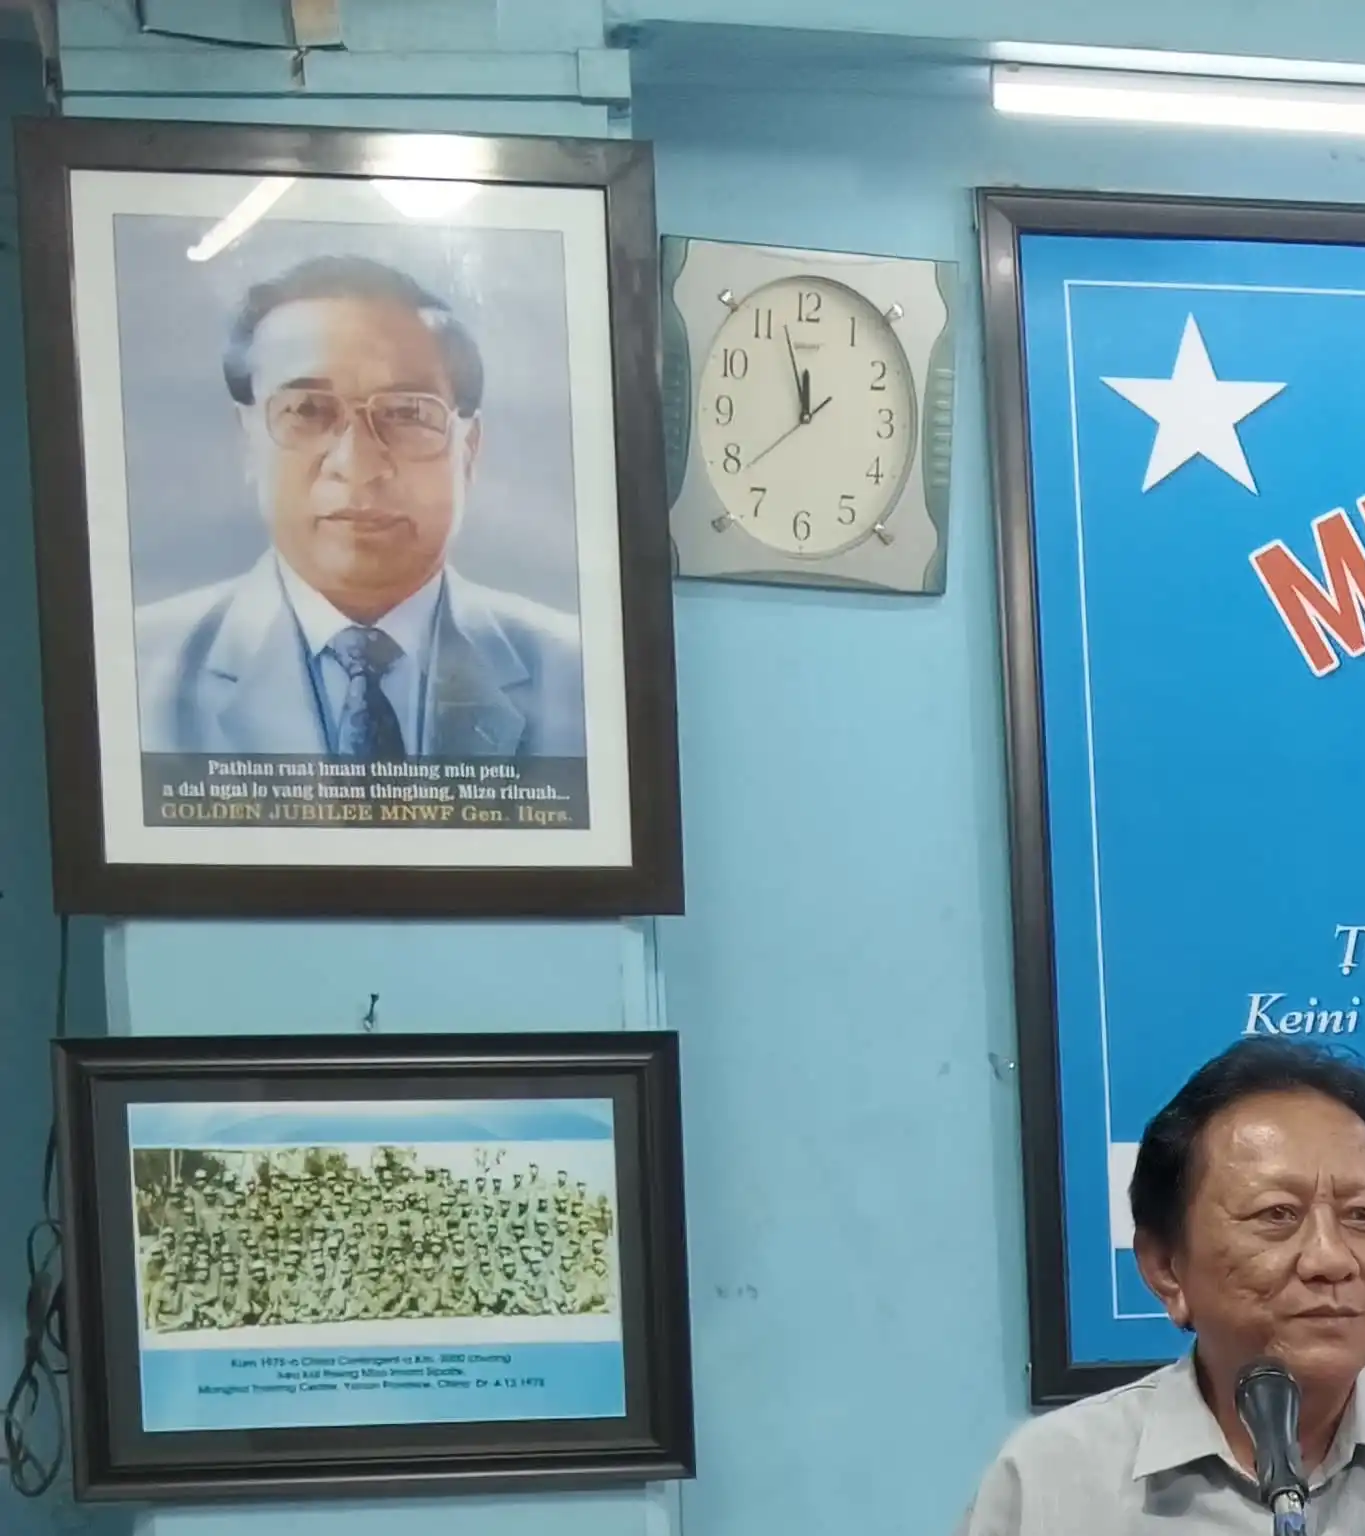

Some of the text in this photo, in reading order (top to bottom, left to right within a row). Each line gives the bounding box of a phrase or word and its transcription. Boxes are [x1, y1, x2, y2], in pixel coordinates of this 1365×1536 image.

[797, 292, 821, 323] 12
[754, 308, 772, 340] 11
[849, 316, 856, 347] 1
[722, 348, 748, 379] 10
[870, 361, 886, 391] 2
[715, 395, 733, 426] 9
[876, 409, 894, 439] 3
[723, 443, 741, 474] 8
[866, 457, 883, 485] 4
[750, 487, 767, 517] 7
[837, 494, 855, 525] 5
[793, 511, 811, 541] 6
[208, 759, 274, 776] Pathian
[318, 761, 366, 777] hnam
[252, 781, 268, 798] lo
[317, 782, 366, 799] hnam
[458, 784, 496, 800] Mizo
[161, 803, 261, 820] GOLDEN
[268, 803, 373, 821] JUBILEE
[380, 805, 454, 822] MNWF
[461, 806, 510, 822] Gen.
[1241, 992, 1361, 1035] Keini
